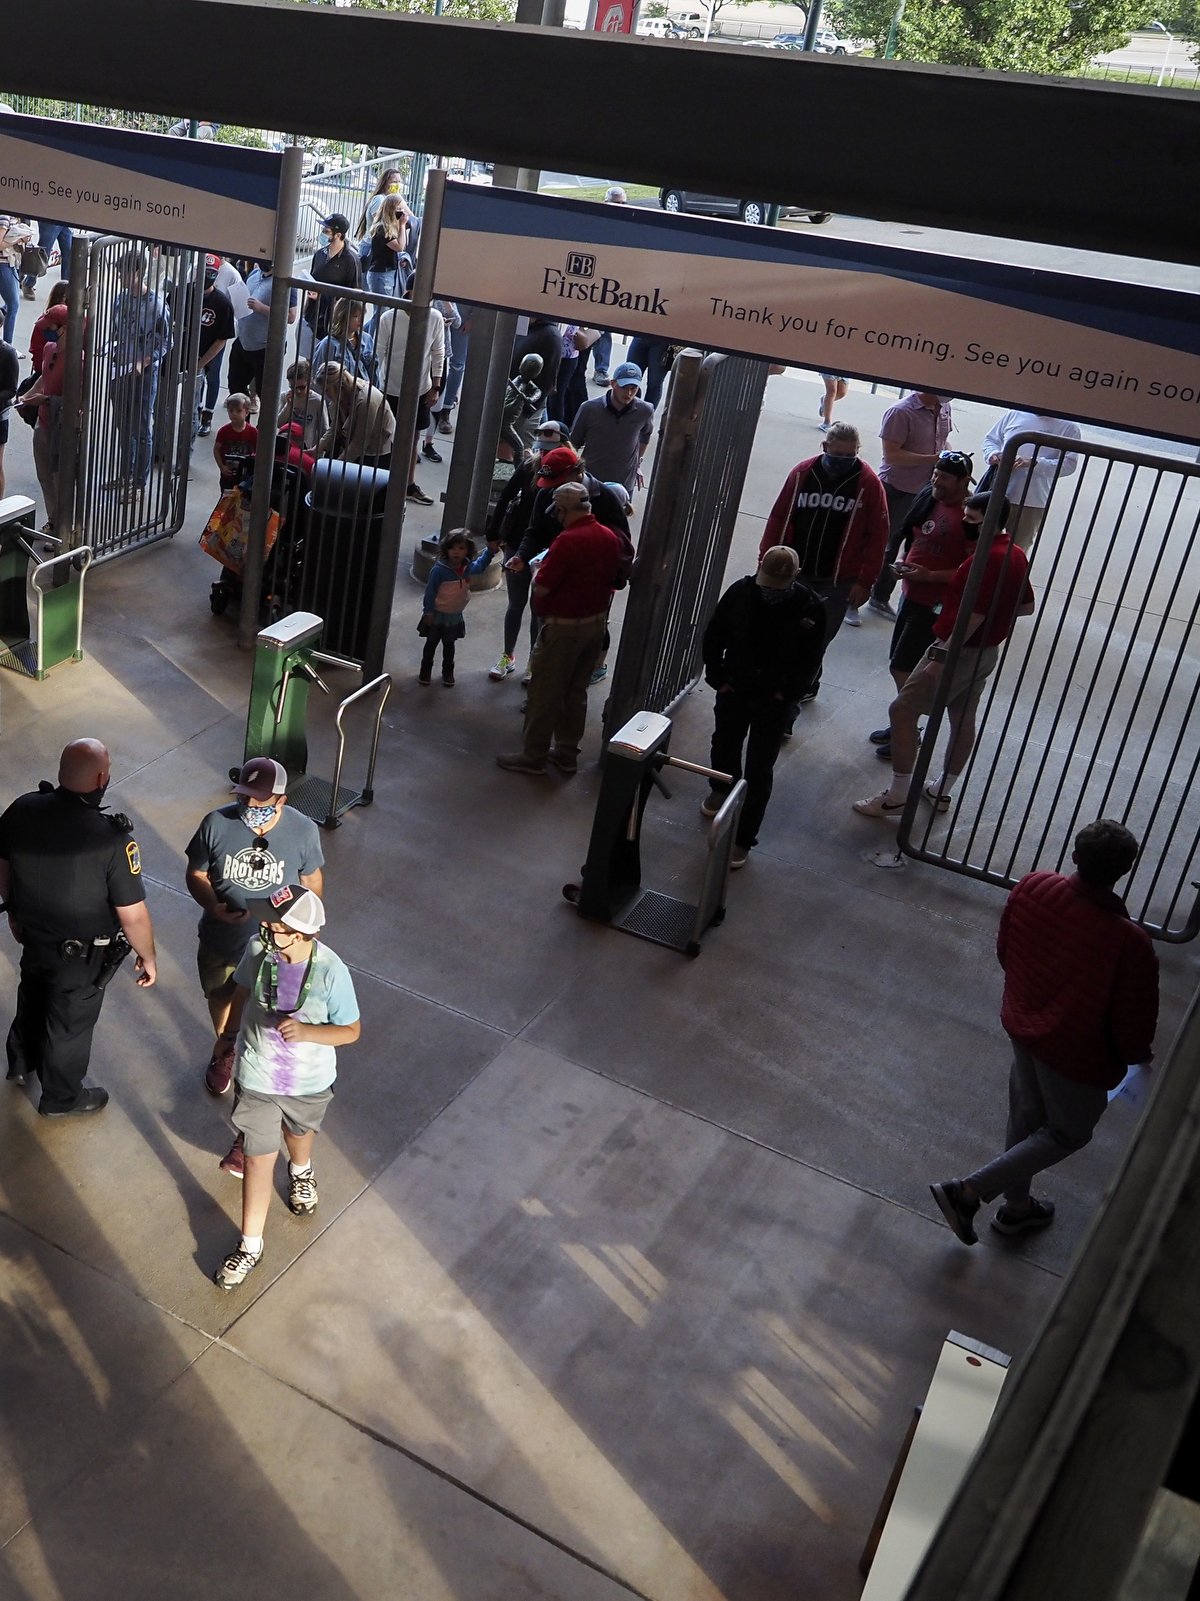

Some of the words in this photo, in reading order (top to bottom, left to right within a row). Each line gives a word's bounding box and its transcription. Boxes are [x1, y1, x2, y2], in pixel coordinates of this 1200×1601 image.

[48, 181, 72, 198] See
[76, 188, 100, 204] you
[104, 194, 141, 212] again
[146, 201, 186, 219] soon!
[568, 255, 594, 276] FB
[541, 268, 669, 316] FirstBank
[710, 297, 774, 326] Thank
[779, 315, 818, 333] you
[826, 318, 858, 340] for
[864, 328, 956, 362] coming.
[965, 343, 1010, 367] See
[1015, 356, 1061, 378] you
[1068, 366, 1139, 392] again
[1147, 381, 1200, 404] soo
